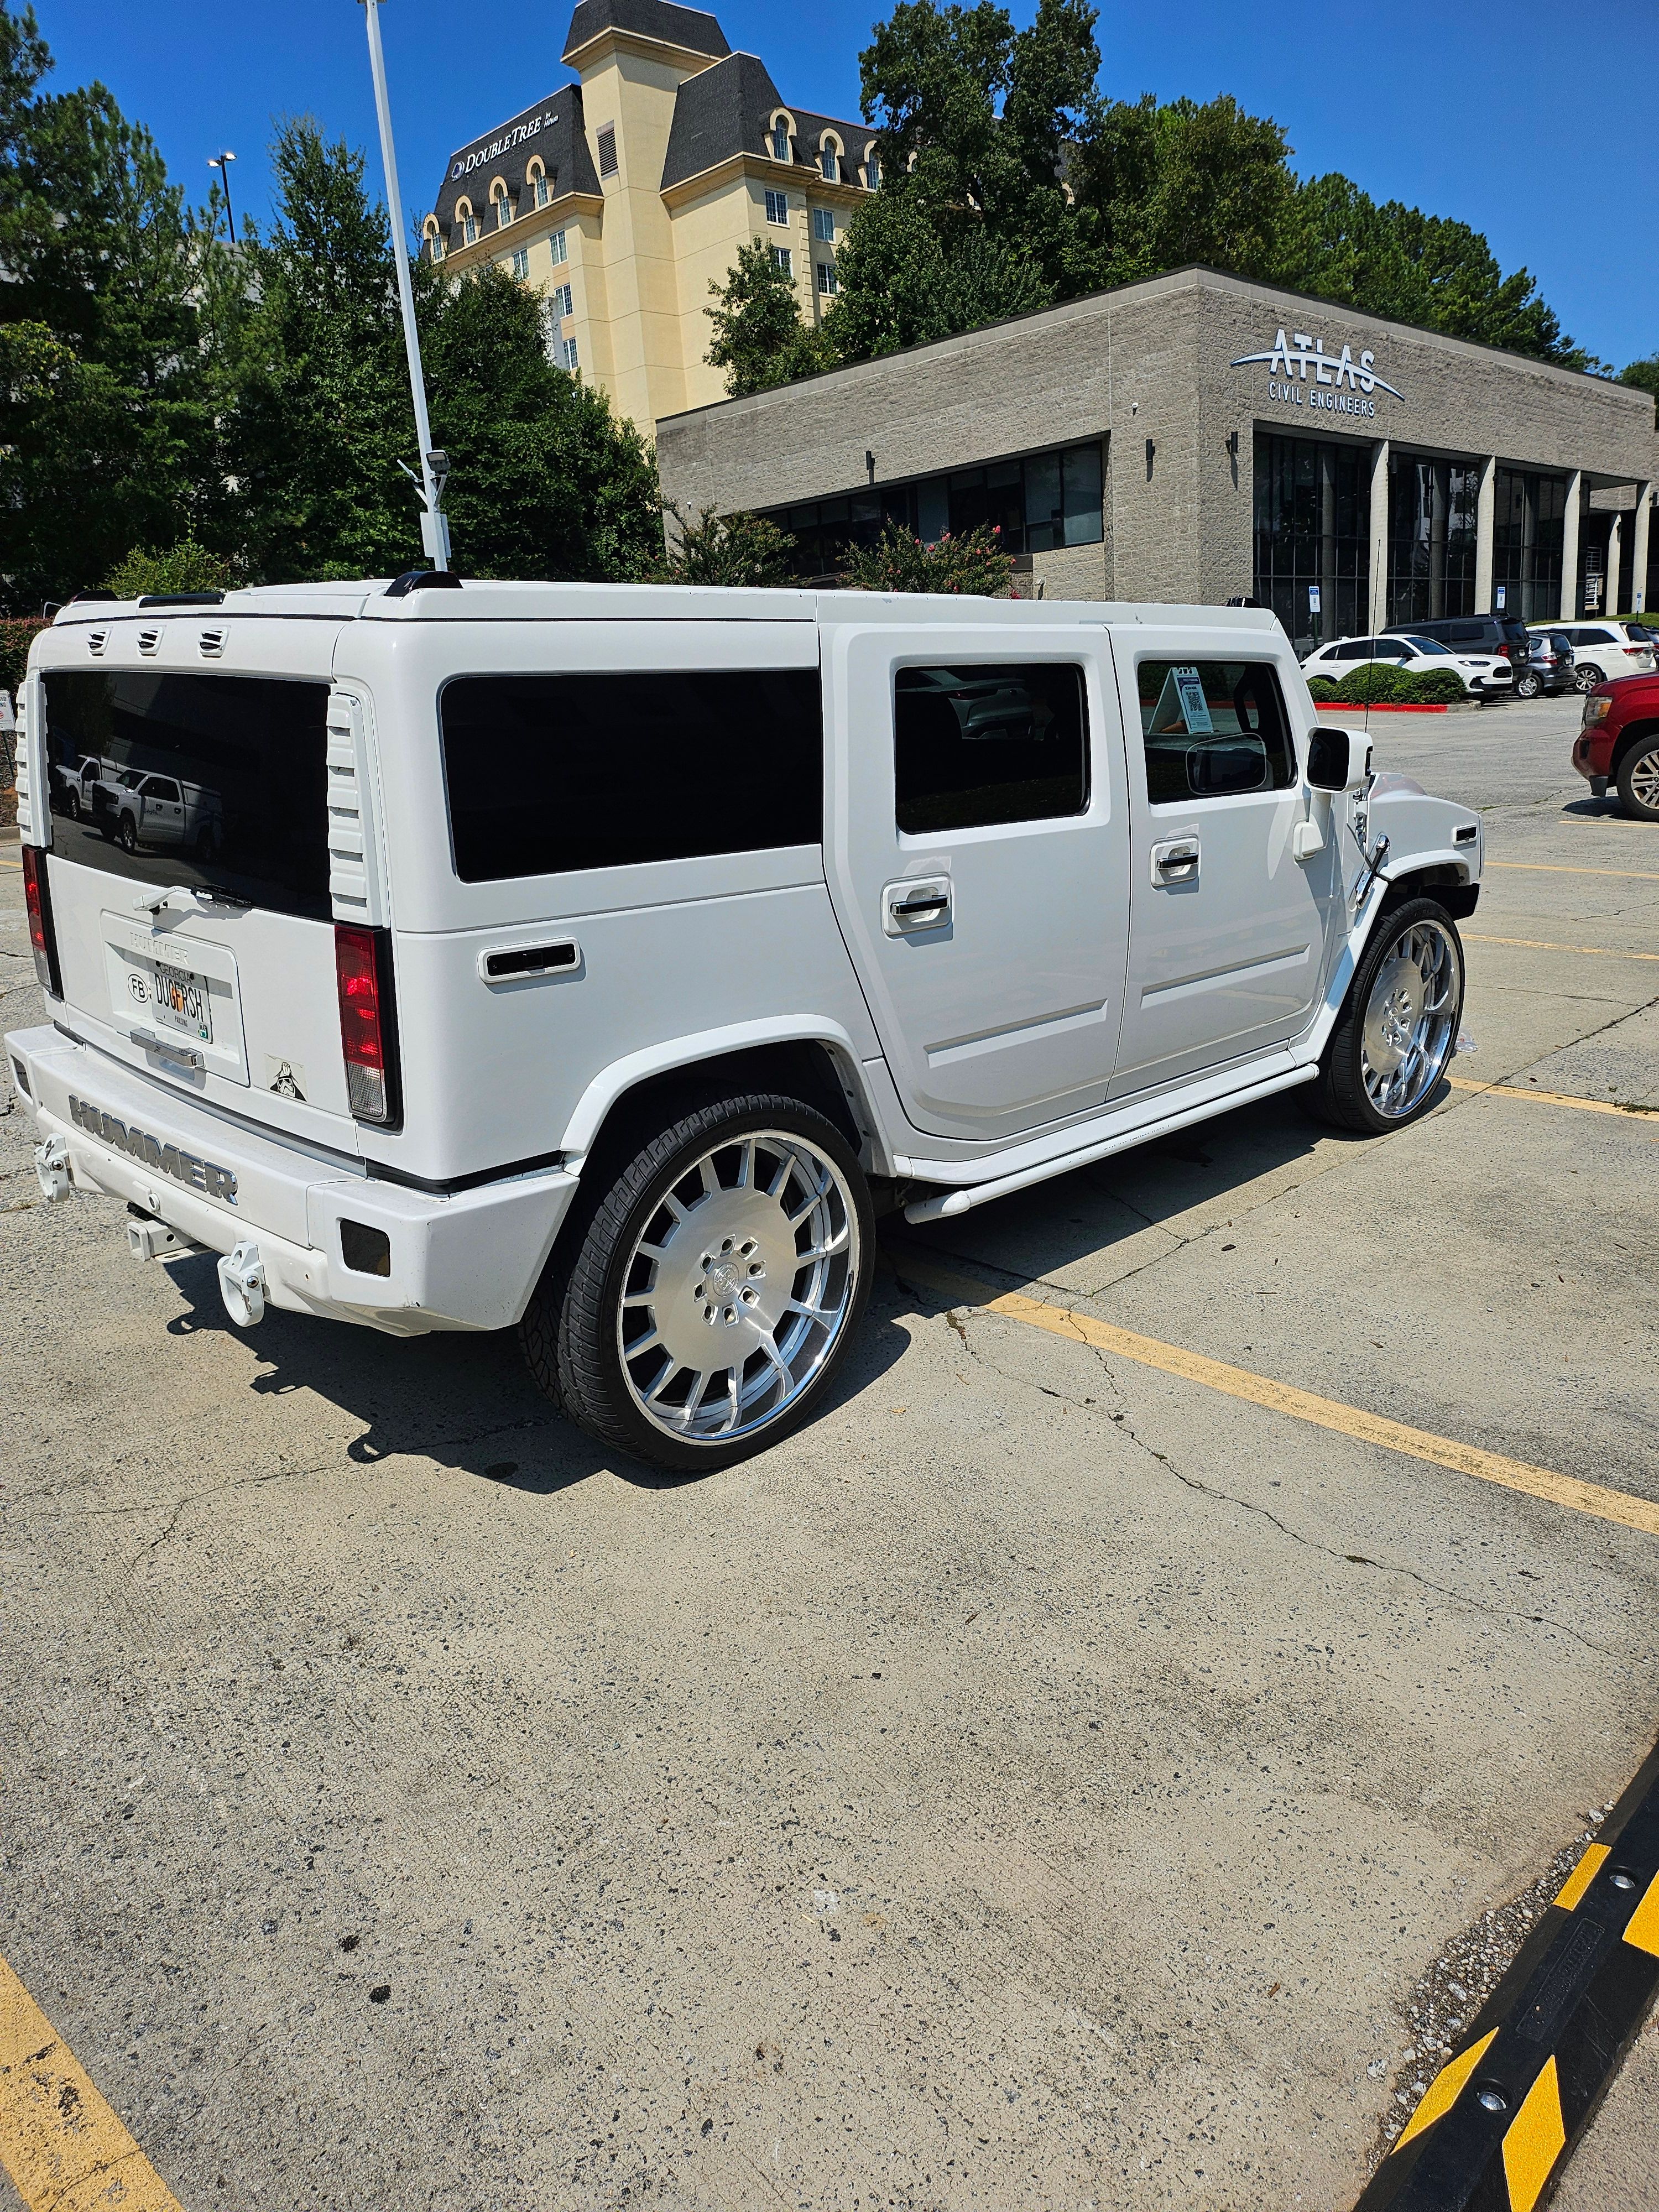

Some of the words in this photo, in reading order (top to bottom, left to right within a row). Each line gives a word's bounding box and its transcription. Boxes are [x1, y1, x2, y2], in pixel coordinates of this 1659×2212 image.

[544, 115, 559, 128] Hilton
[465, 116, 542, 173] DOUBLETREE
[1270, 328, 1375, 393] ATLAS
[1270, 382, 1302, 404] CIVIL
[1310, 389, 1374, 416] ENGINEERS
[130, 932, 190, 966] HUMMER
[132, 978, 145, 998] FB
[159, 963, 192, 984] GEORGIA
[69, 1093, 238, 1206] HUMMER
